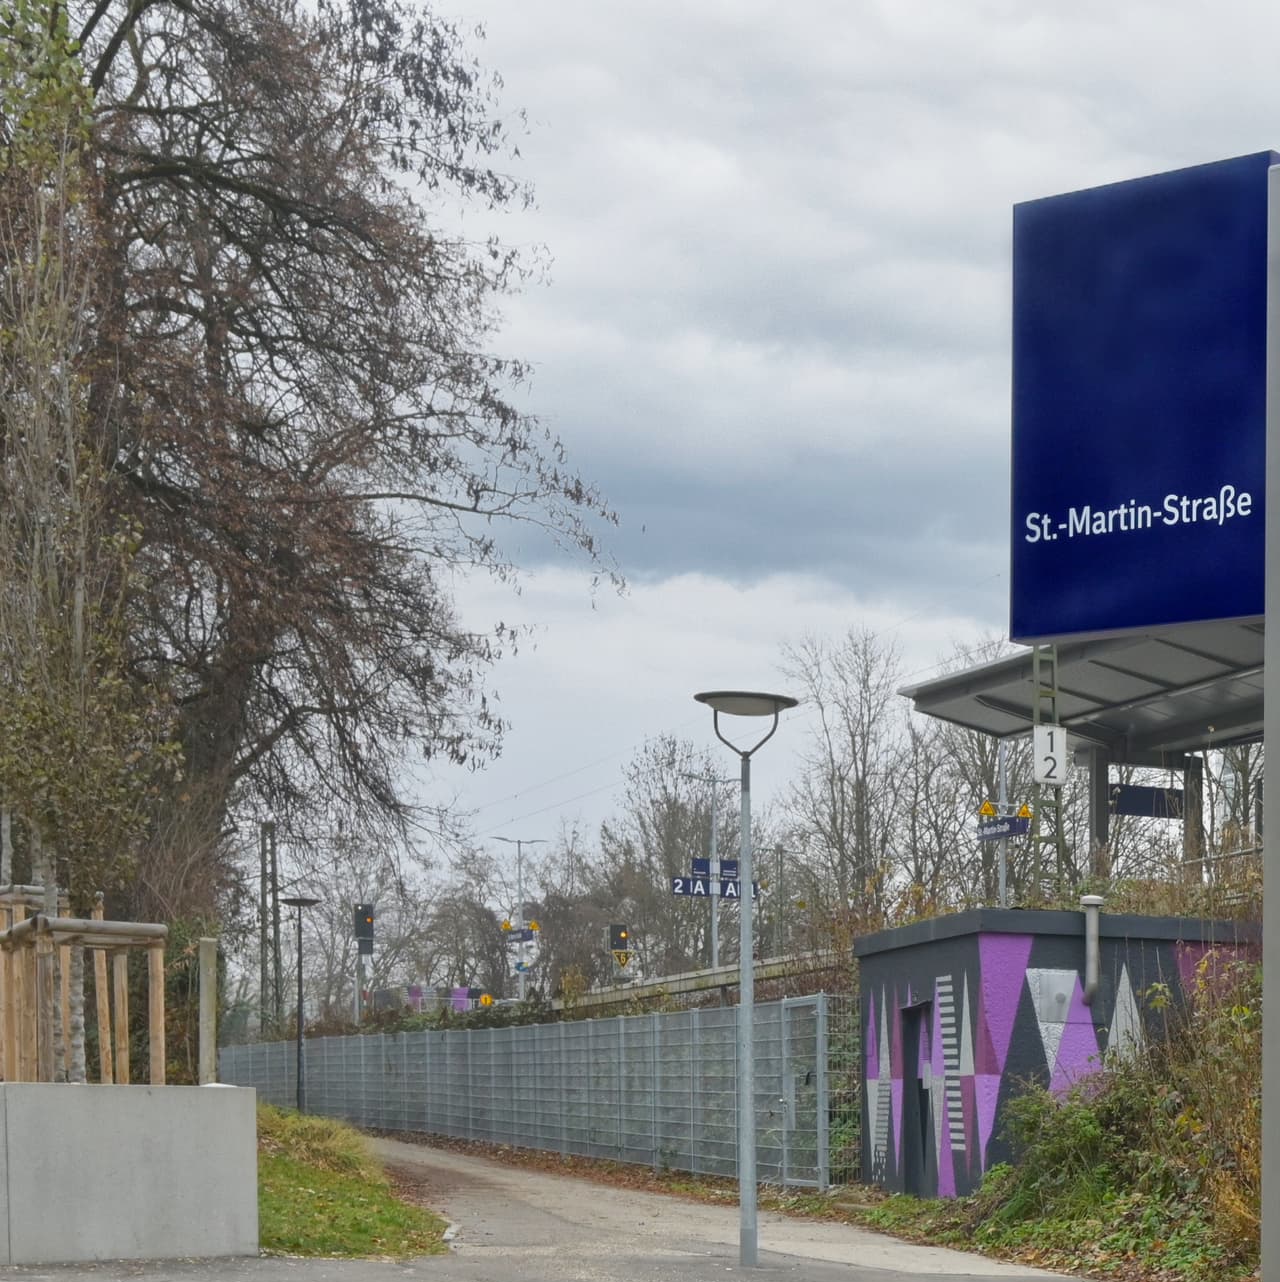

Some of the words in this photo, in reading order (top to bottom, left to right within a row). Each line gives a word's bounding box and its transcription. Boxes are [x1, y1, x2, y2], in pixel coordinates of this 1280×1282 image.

[1024, 484, 1253, 544] St.-Martin-Straße
[1047, 730, 1054, 753] 1
[1044, 756, 1057, 779] 2
[674, 878, 683, 894] 2
[693, 880, 705, 895] A
[725, 882, 737, 897] A
